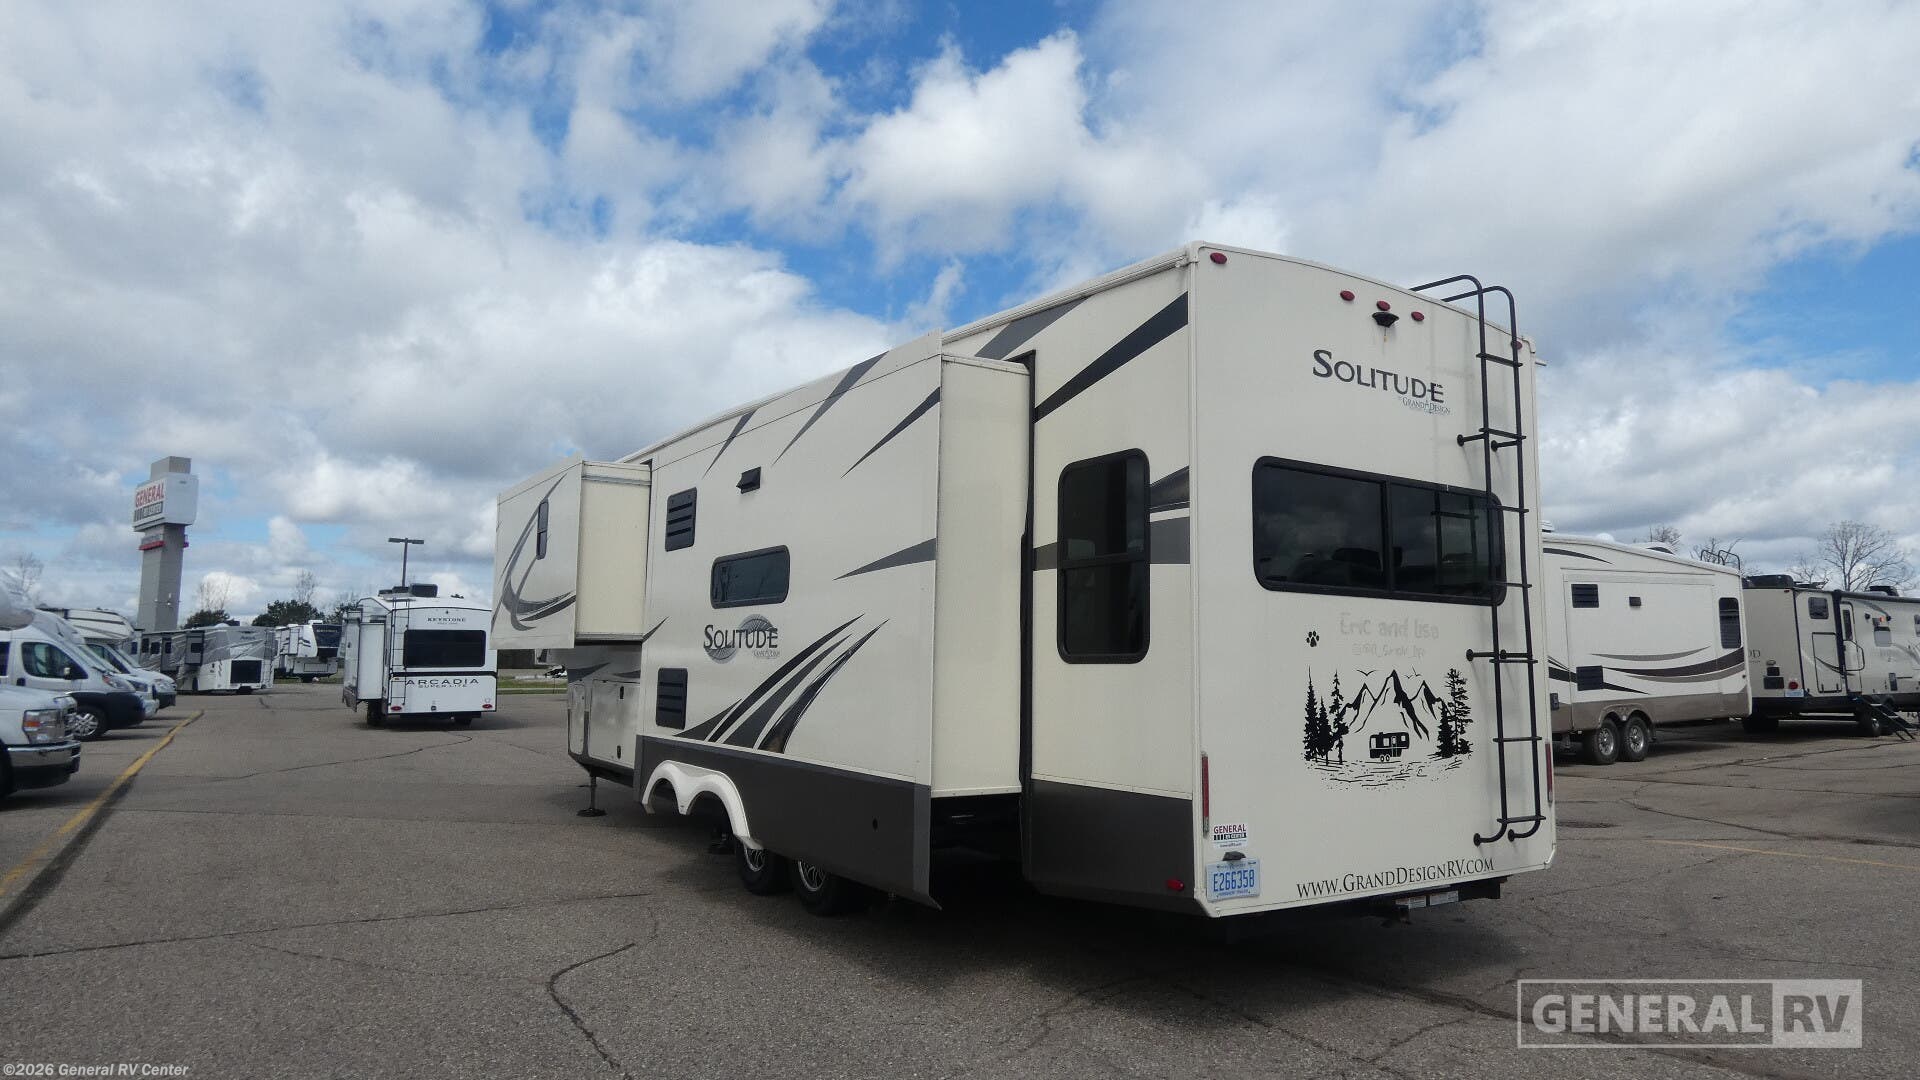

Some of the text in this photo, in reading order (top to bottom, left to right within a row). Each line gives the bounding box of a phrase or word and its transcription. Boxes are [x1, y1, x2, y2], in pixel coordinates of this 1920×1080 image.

[1312, 349, 1445, 403] SOLITUDE
[135, 483, 164, 508] GENERAL
[703, 625, 778, 650] SOLITUDE
[1213, 824, 1247, 834] GENERAL
